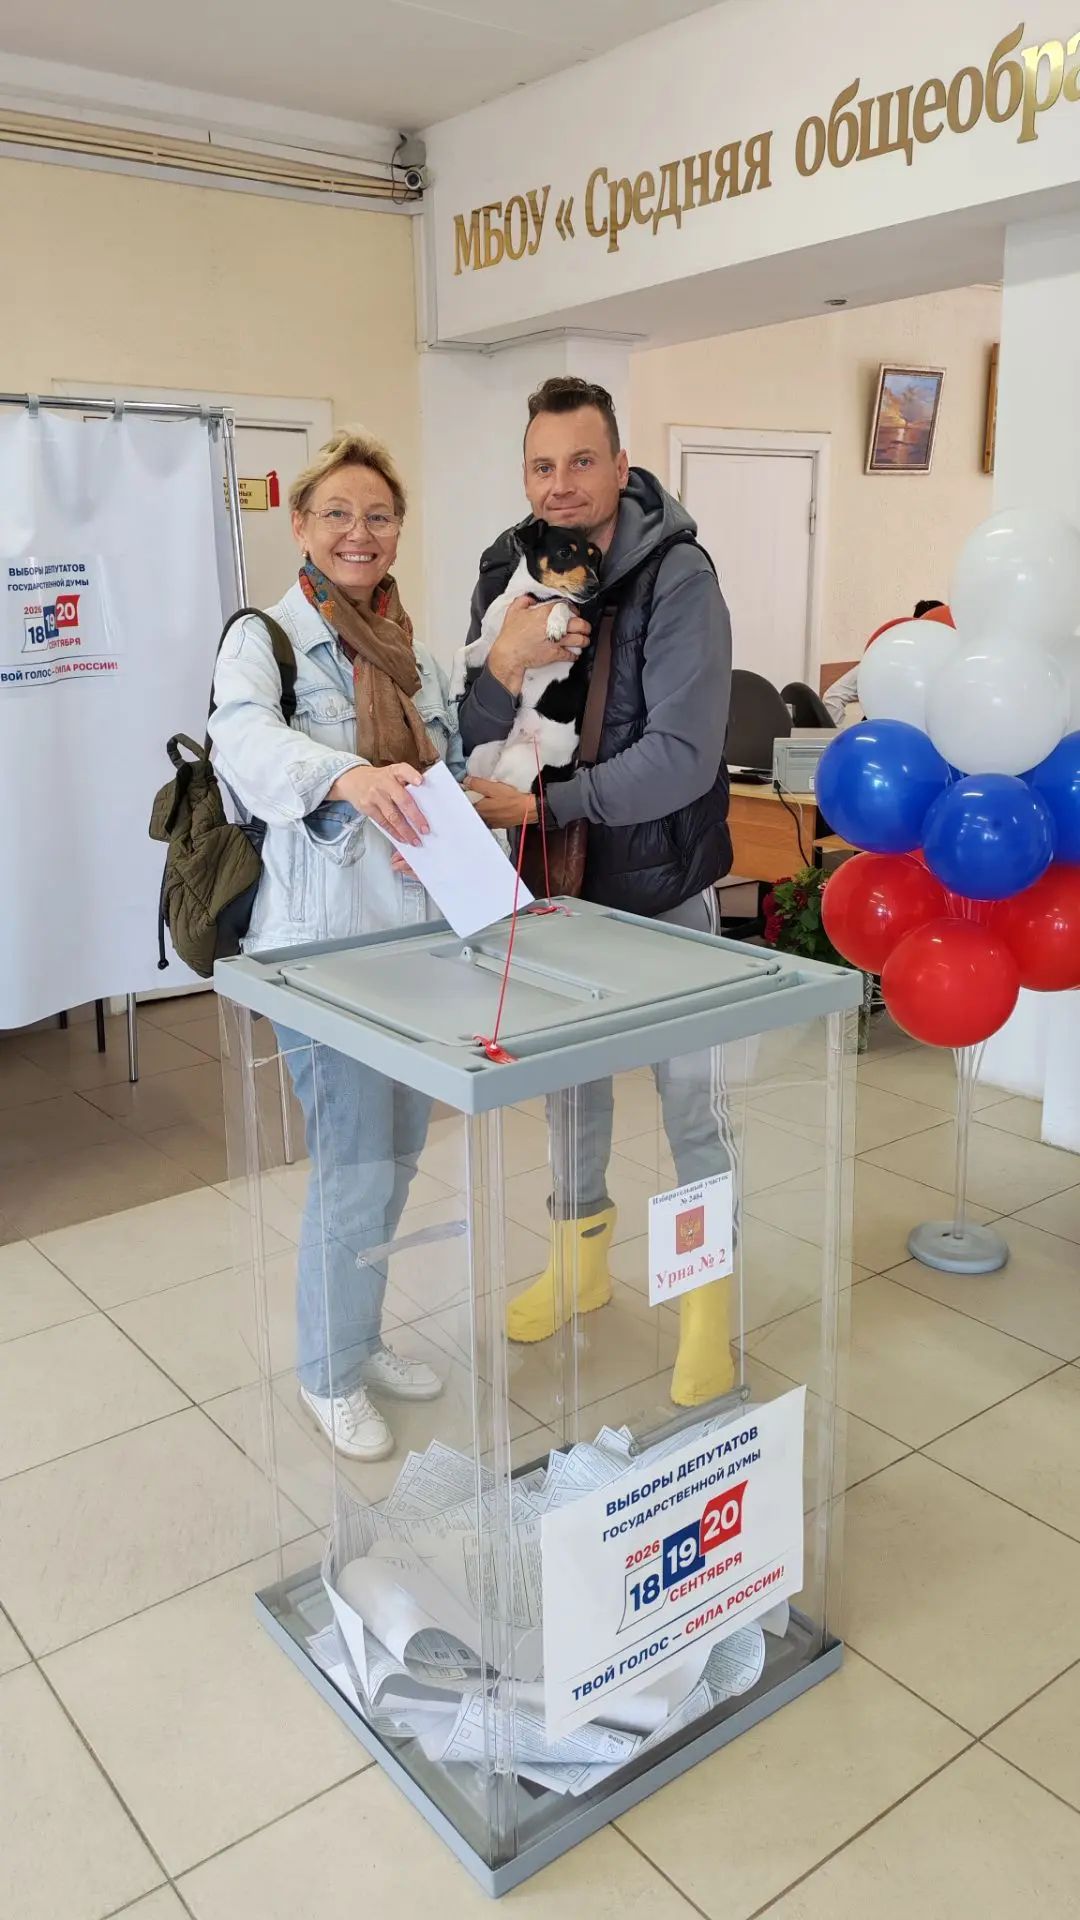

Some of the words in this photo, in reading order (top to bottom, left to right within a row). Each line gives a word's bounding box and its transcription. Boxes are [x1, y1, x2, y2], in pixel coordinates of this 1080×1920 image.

[453, 184, 551, 276] МБОУ
[584, 130, 773, 253] Средняя
[9, 565, 43, 577] ВЫБОРЫ
[45, 563, 86, 576] ДЕПУТАТОВ
[66, 579, 89, 587] ДУМЫ
[46, 613, 55, 632] 19
[56, 602, 76, 621] 20
[28, 626, 45, 644] 18
[25, 669, 52, 680] ГОЛОС
[73, 662, 118, 671] РОССИИ!
[656, 1265, 694, 1288] Урна
[699, 1254, 715, 1272] №
[719, 1248, 726, 1264] 2
[606, 1470, 673, 1517] ВЫБОРЫ
[677, 1426, 759, 1480] ДЕПУТАТОВ
[602, 1467, 724, 1542] ГОСУДАРСТВЕННОЙ
[727, 1449, 761, 1478] ДУМЫ
[703, 1500, 739, 1542] 20
[625, 1540, 660, 1569] 2026
[667, 1537, 697, 1574] 19
[630, 1574, 659, 1612] 18
[669, 1552, 743, 1603] СЕНТЯБРЯ
[572, 1662, 615, 1701] ТВОЙ
[619, 1637, 669, 1675] ГОЛОС
[685, 1605, 723, 1635] СИЛА
[727, 1566, 785, 1608] РОССИИ!
